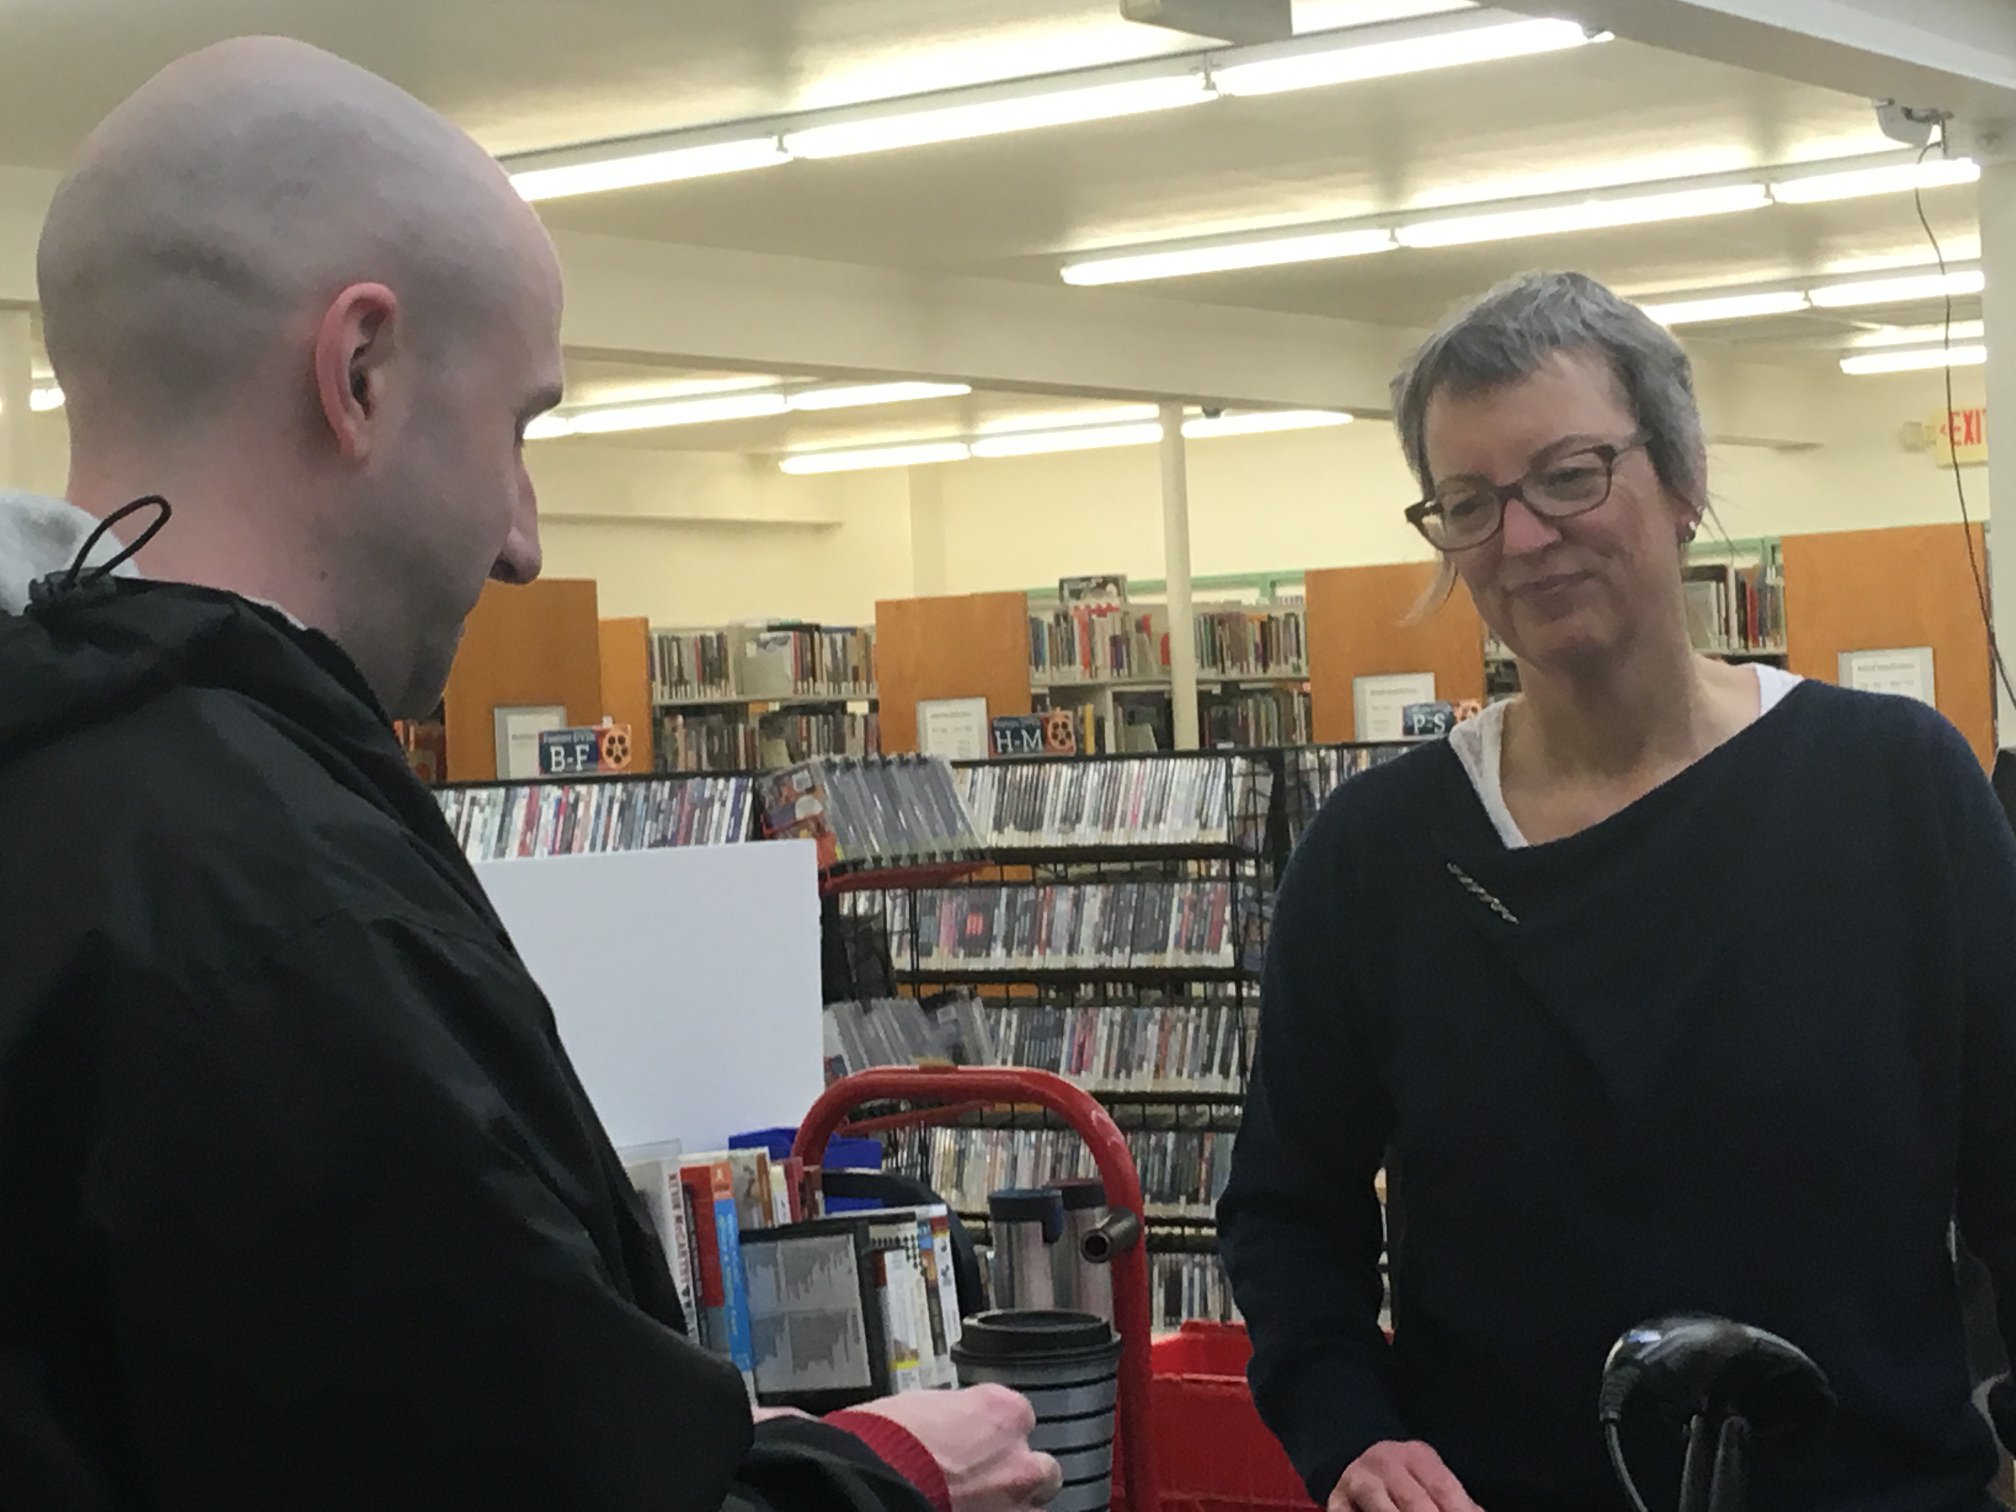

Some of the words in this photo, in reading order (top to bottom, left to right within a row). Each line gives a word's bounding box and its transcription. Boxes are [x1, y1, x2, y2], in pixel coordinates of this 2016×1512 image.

[1949, 408, 1987, 446] EXI
[1412, 712, 1446, 736] P-S
[994, 728, 1043, 753] H-M
[549, 744, 590, 773] B-F
